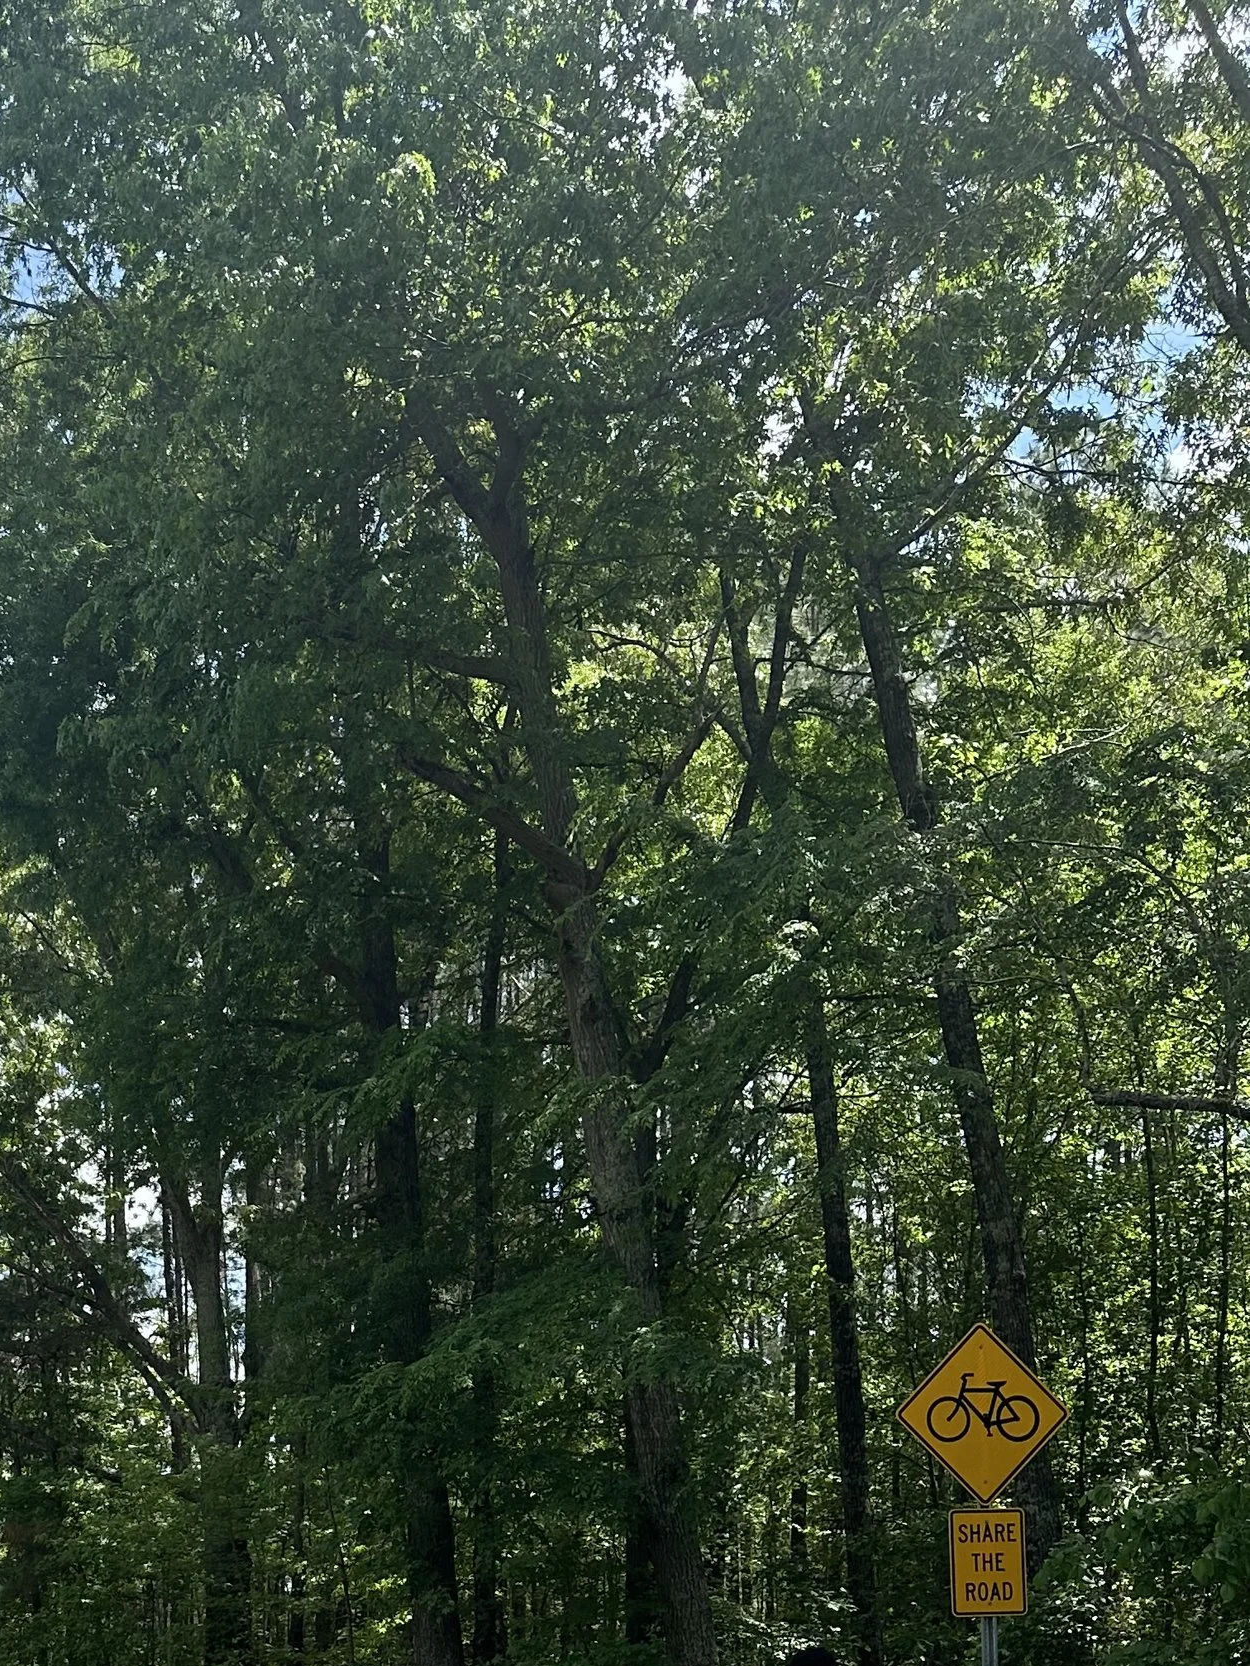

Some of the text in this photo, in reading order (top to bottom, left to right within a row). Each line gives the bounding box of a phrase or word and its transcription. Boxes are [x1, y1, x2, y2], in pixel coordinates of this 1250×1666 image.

[958, 1523, 1017, 1543] SHARE
[971, 1552, 1005, 1572] THE
[965, 1582, 1013, 1601] ROAD
